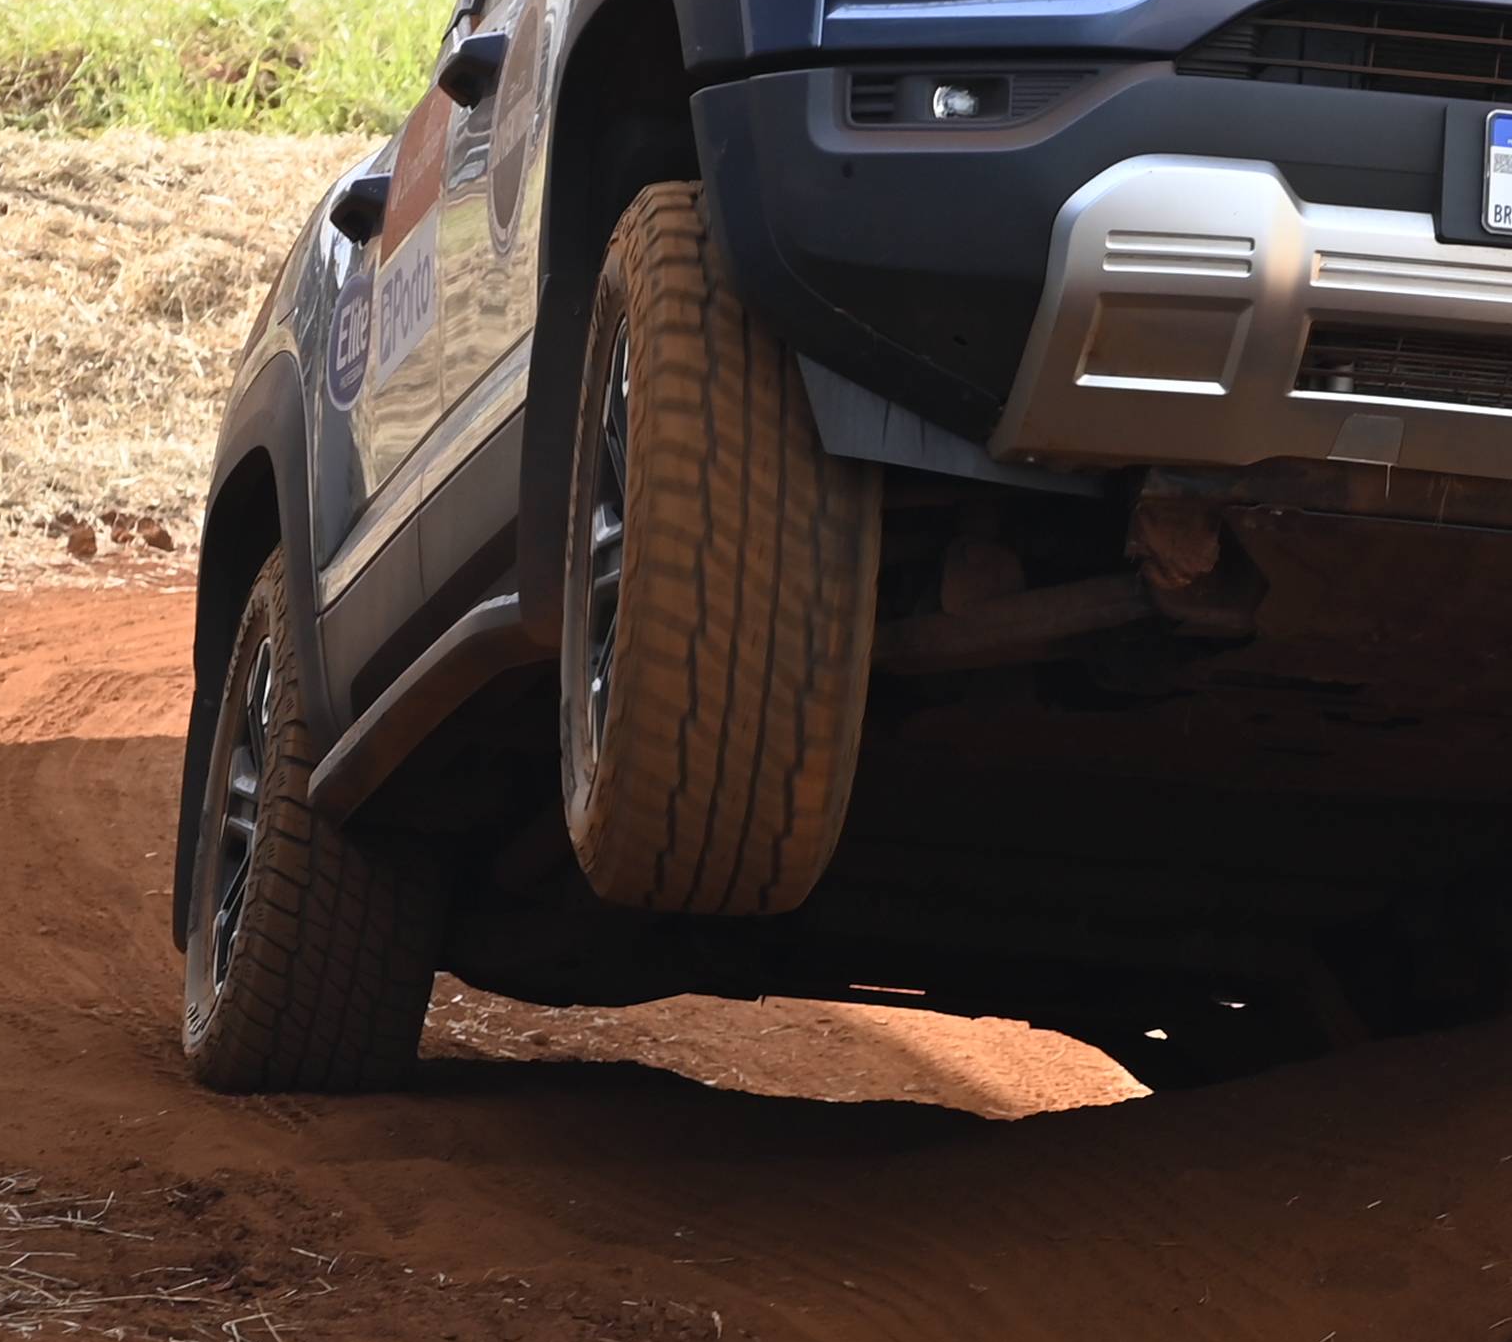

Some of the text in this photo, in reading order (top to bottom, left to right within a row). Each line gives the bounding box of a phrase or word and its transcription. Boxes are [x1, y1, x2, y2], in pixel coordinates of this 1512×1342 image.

[1494, 204, 1512, 226] BR
[336, 297, 369, 371] Elite
[391, 249, 431, 353] Porto
